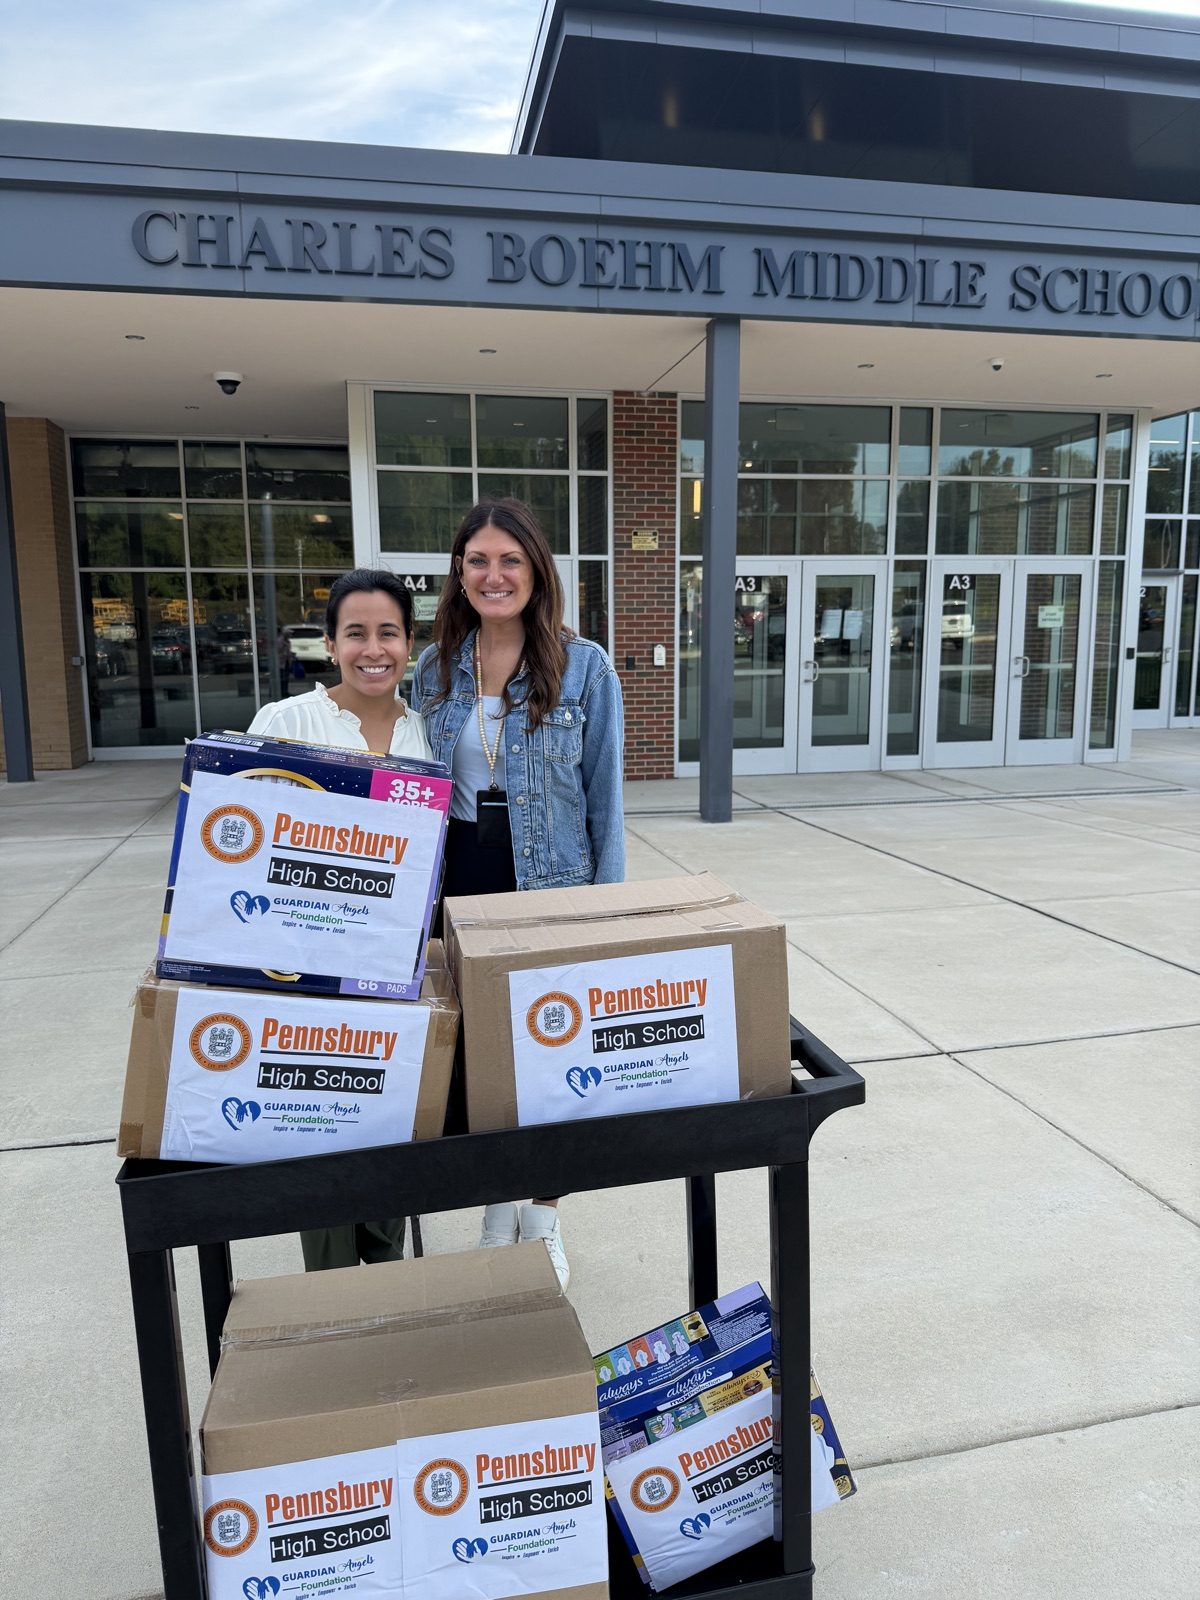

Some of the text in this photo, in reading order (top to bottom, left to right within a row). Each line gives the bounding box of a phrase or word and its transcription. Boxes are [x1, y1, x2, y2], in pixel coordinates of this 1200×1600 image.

[131, 209, 1200, 322] CHARLES BOEHM MIDDLE SCHOO
[404, 576, 428, 591] A4
[735, 577, 756, 591] A3
[949, 576, 970, 589] A3
[390, 779, 434, 800] 35+
[273, 813, 408, 865] Pennsbury
[269, 862, 394, 894] High School
[274, 898, 369, 916] GUARDIAN Angels
[290, 910, 343, 924] Foundation
[358, 979, 407, 993] 66 PADS
[588, 978, 707, 1016] Pennsbury
[261, 1018, 398, 1060] Pennsbury
[594, 1018, 704, 1050] High School
[604, 1051, 689, 1073] GUARDIAN Angels
[259, 1066, 384, 1090] High School
[621, 1070, 668, 1081] Foundation
[264, 1101, 361, 1116] GUARDIAN Angels
[281, 1115, 334, 1124] Foundation
[599, 1378, 643, 1402] always
[615, 1391, 631, 1400] MAXI
[667, 1370, 712, 1397] always
[678, 1416, 773, 1477] Pennsbur
[476, 1443, 596, 1483] Pennsbury
[694, 1455, 773, 1500] High Scho
[265, 1478, 393, 1523] Pennsbury
[481, 1497, 523, 1520] High
[530, 1485, 591, 1511] School
[710, 1492, 753, 1514] GUARDIAN
[727, 1494, 768, 1516] Foundation
[271, 1519, 389, 1559] High School
[490, 1518, 576, 1543] GUARDIAN Angels
[507, 1538, 555, 1552] Foundation
[282, 1554, 374, 1582] GUARDIAN Angels
[301, 1576, 351, 1591] Foundation
